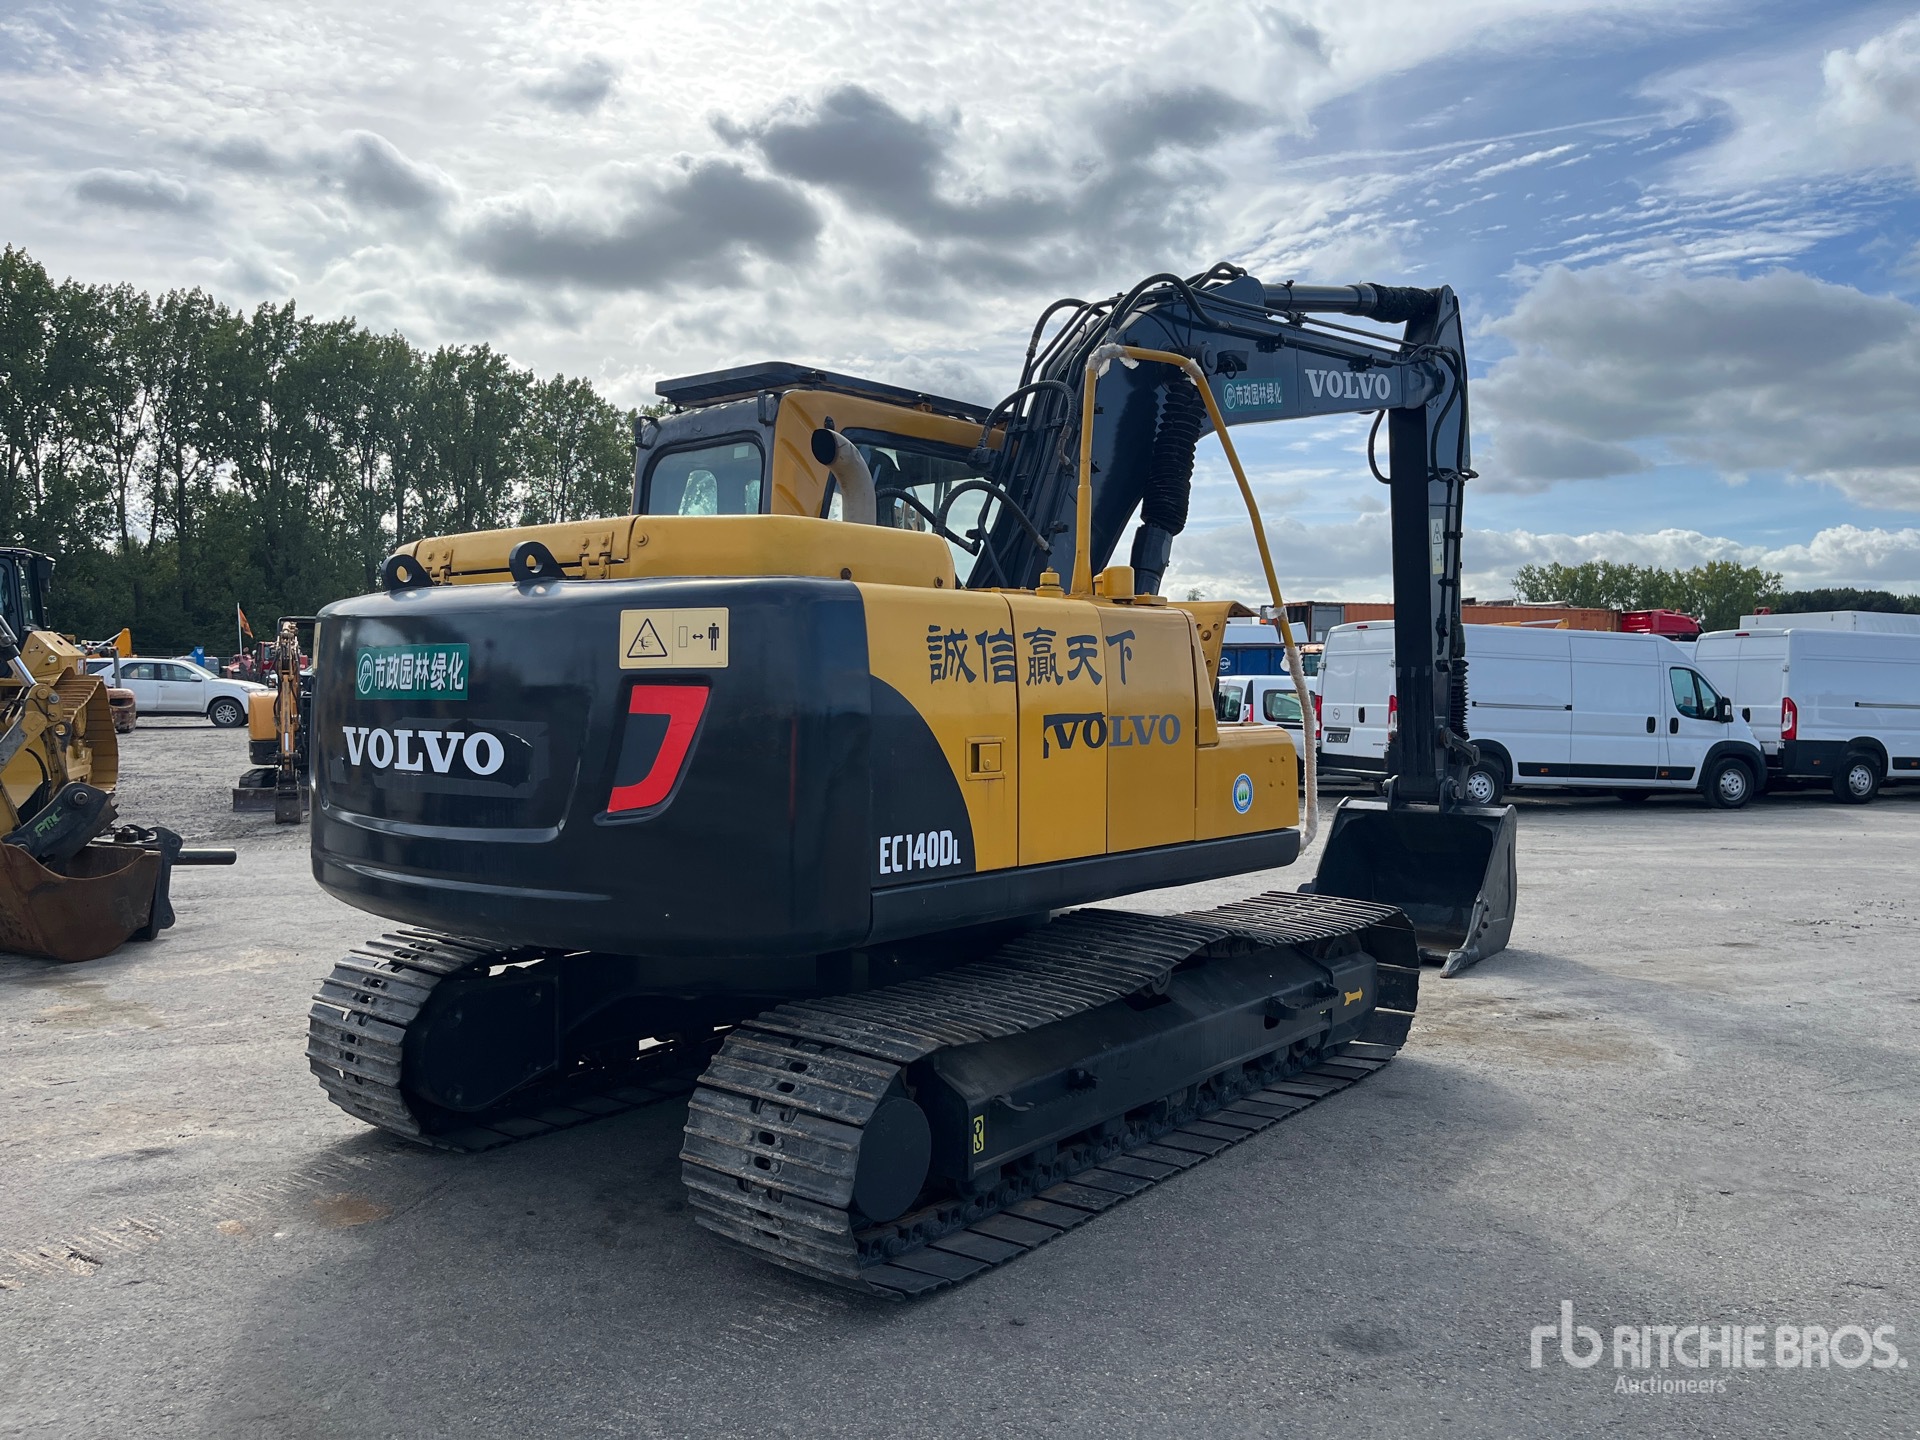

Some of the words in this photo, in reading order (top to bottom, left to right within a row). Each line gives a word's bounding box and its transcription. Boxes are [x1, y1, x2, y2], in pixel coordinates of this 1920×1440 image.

[1235, 381, 1282, 406] 市政园林绿化
[1305, 368, 1391, 400] VOLVO
[374, 652, 464, 691] 市政园林绿化
[1051, 713, 1181, 749] VOLVO
[343, 726, 505, 776] VOLVO
